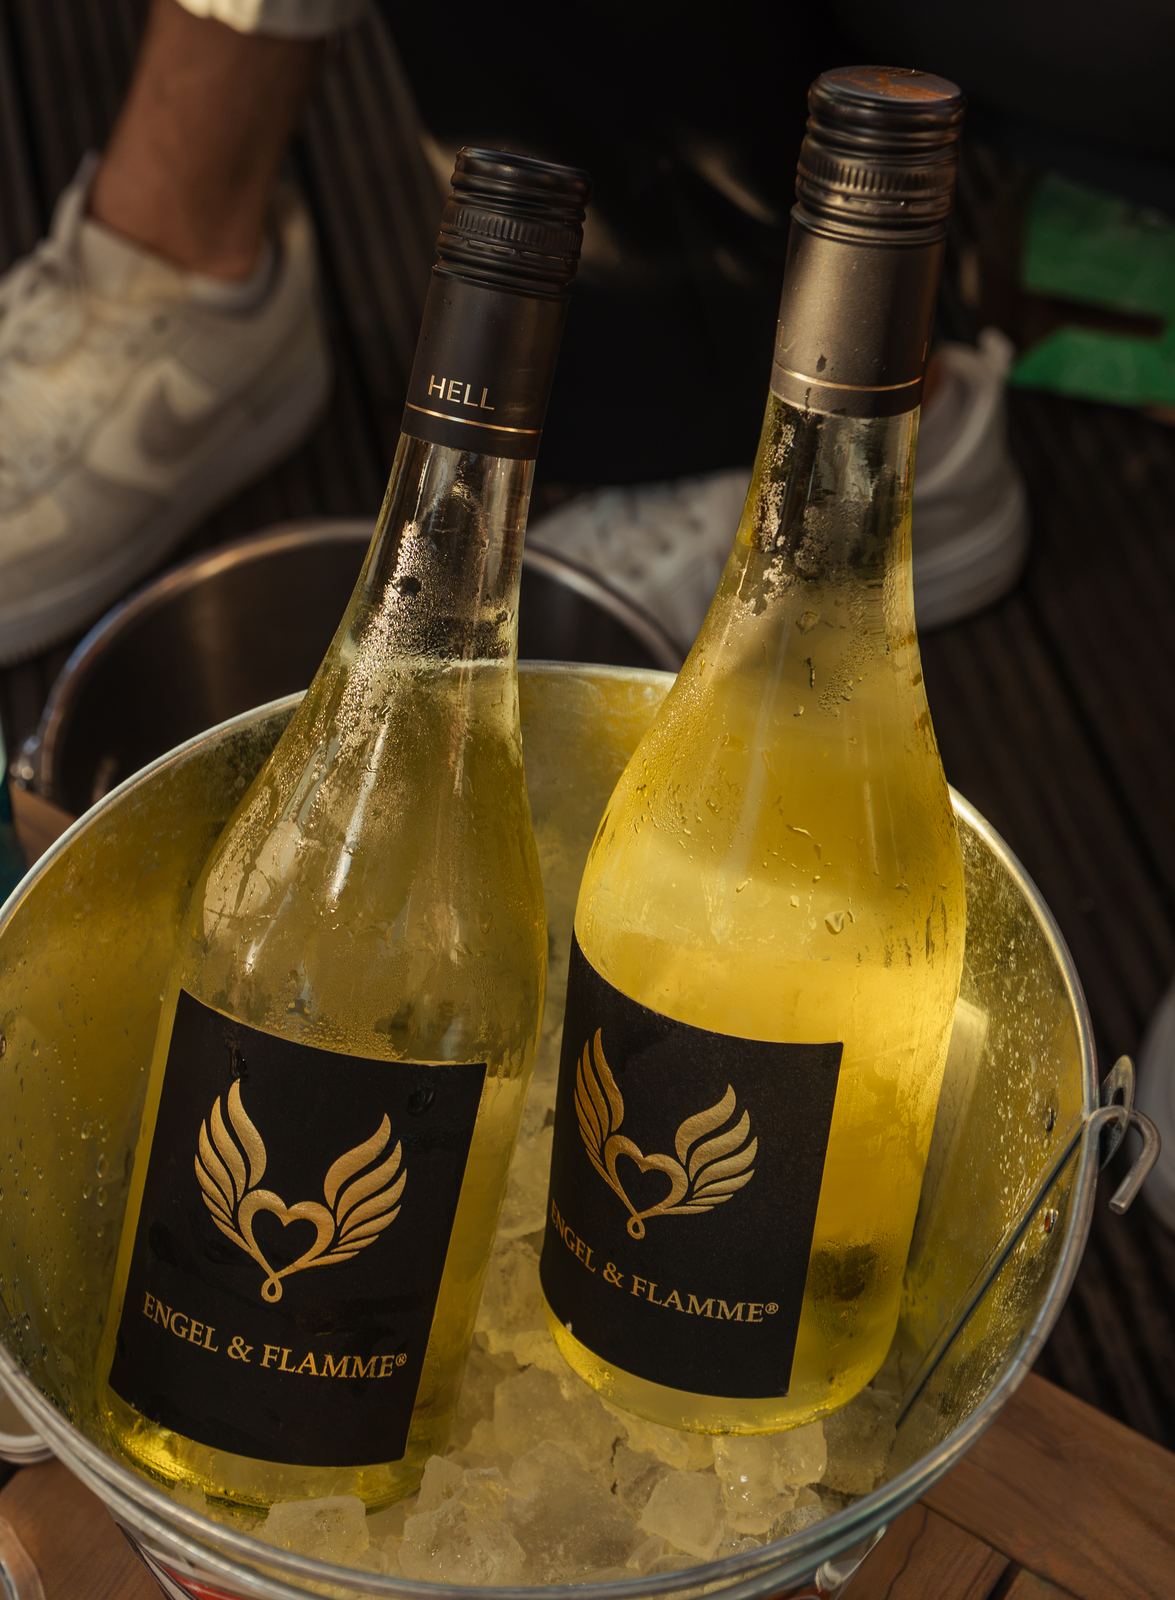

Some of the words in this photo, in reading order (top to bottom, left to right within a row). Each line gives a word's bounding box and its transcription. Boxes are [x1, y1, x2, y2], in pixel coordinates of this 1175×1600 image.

[428, 374, 496, 411] HELL
[551, 1198, 597, 1273] ENGEL
[602, 1261, 625, 1288] &
[142, 1291, 219, 1353] ENGEL
[227, 1335, 254, 1363] &
